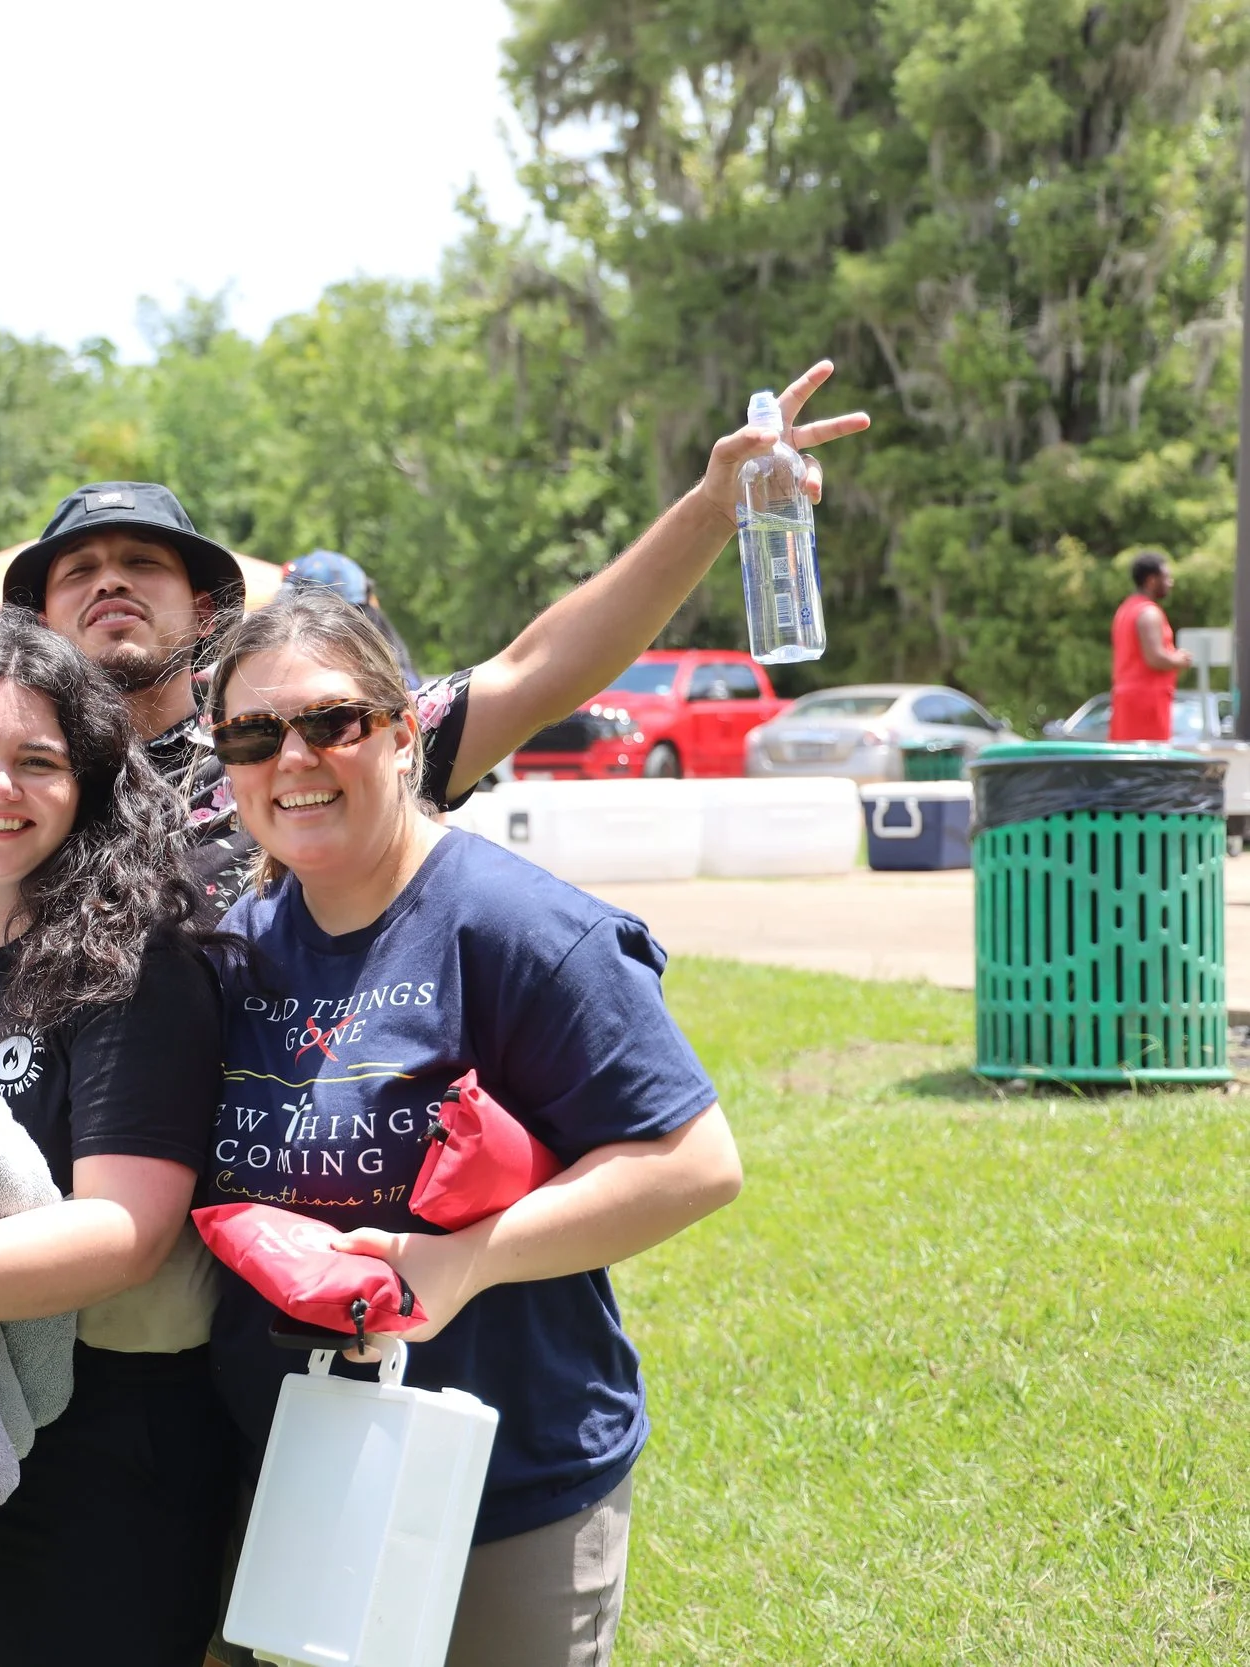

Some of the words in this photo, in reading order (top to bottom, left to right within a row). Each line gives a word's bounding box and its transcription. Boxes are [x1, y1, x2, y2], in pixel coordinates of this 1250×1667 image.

[244, 996, 299, 1022] OLD
[312, 982, 435, 1020] THINGS
[285, 1019, 366, 1051] GONE
[213, 1103, 269, 1133] EW
[215, 1139, 383, 1176] COMING
[215, 1170, 364, 1205] Corinthians
[372, 1186, 406, 1204] 5:17
